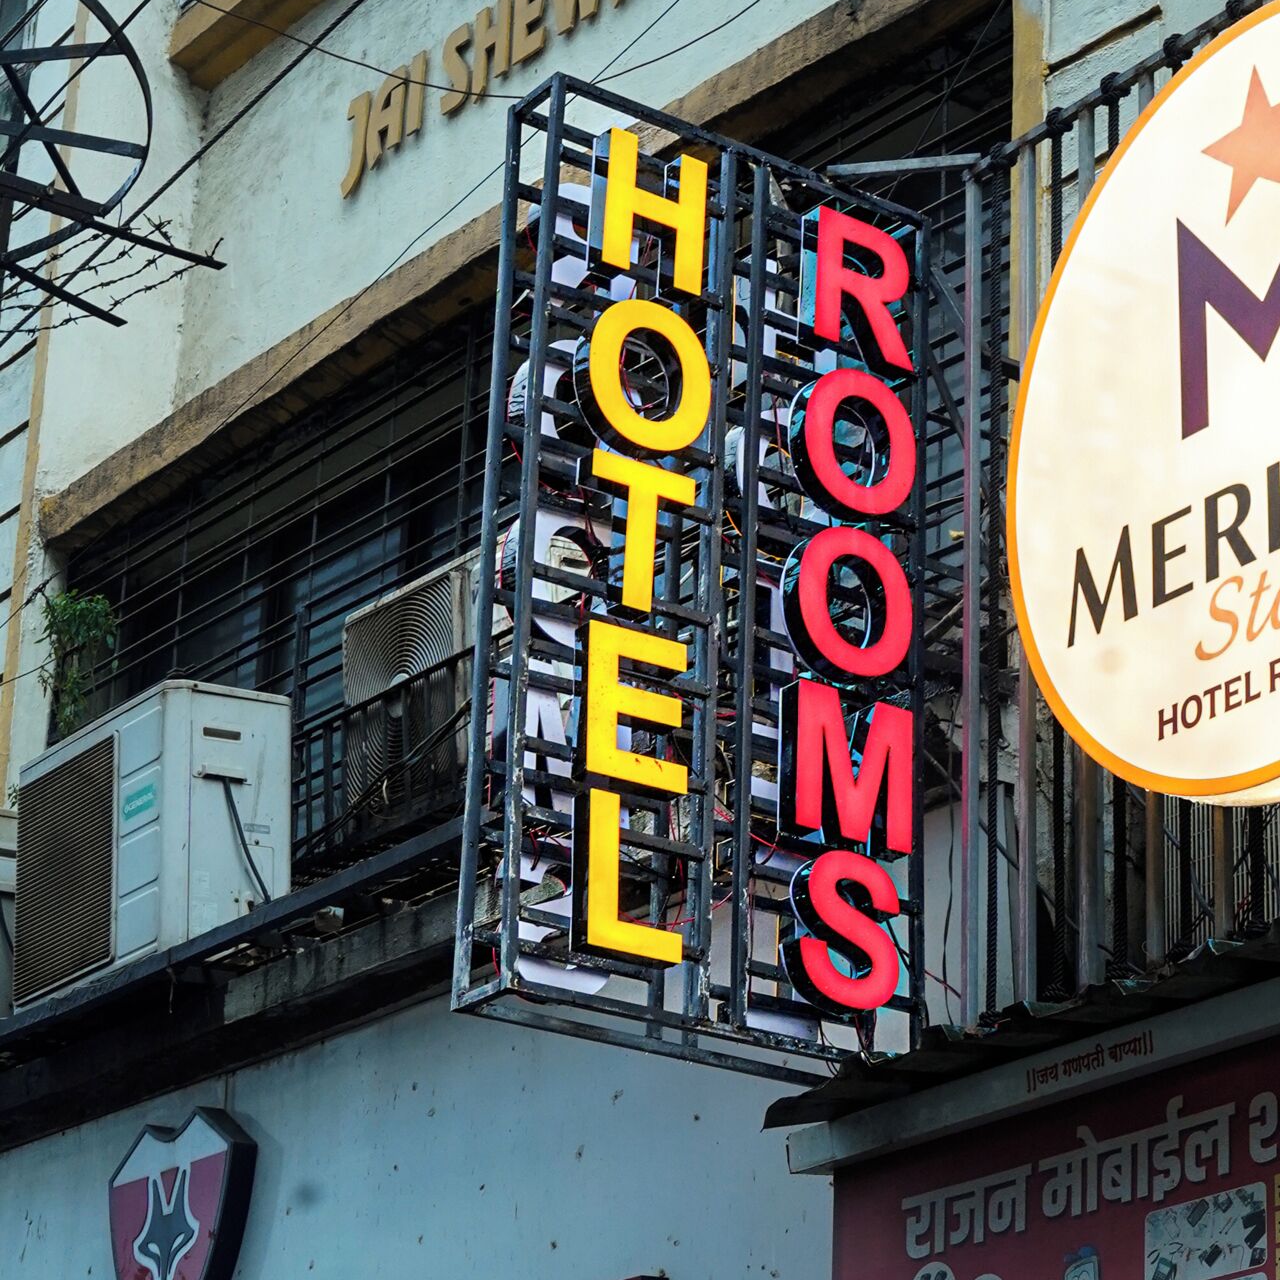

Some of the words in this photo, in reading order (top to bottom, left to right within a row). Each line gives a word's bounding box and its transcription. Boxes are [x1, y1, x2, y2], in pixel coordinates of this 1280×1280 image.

[341, 50, 427, 200] JAI
[584, 126, 711, 966] HOTEL
[792, 204, 918, 1011] ROOMS
[1156, 672, 1263, 742] HOTEL
[1062, 1043, 1105, 1078] गणपती
[902, 1157, 1035, 1261] राजन
[1038, 1094, 1237, 1221] मोबाईल
